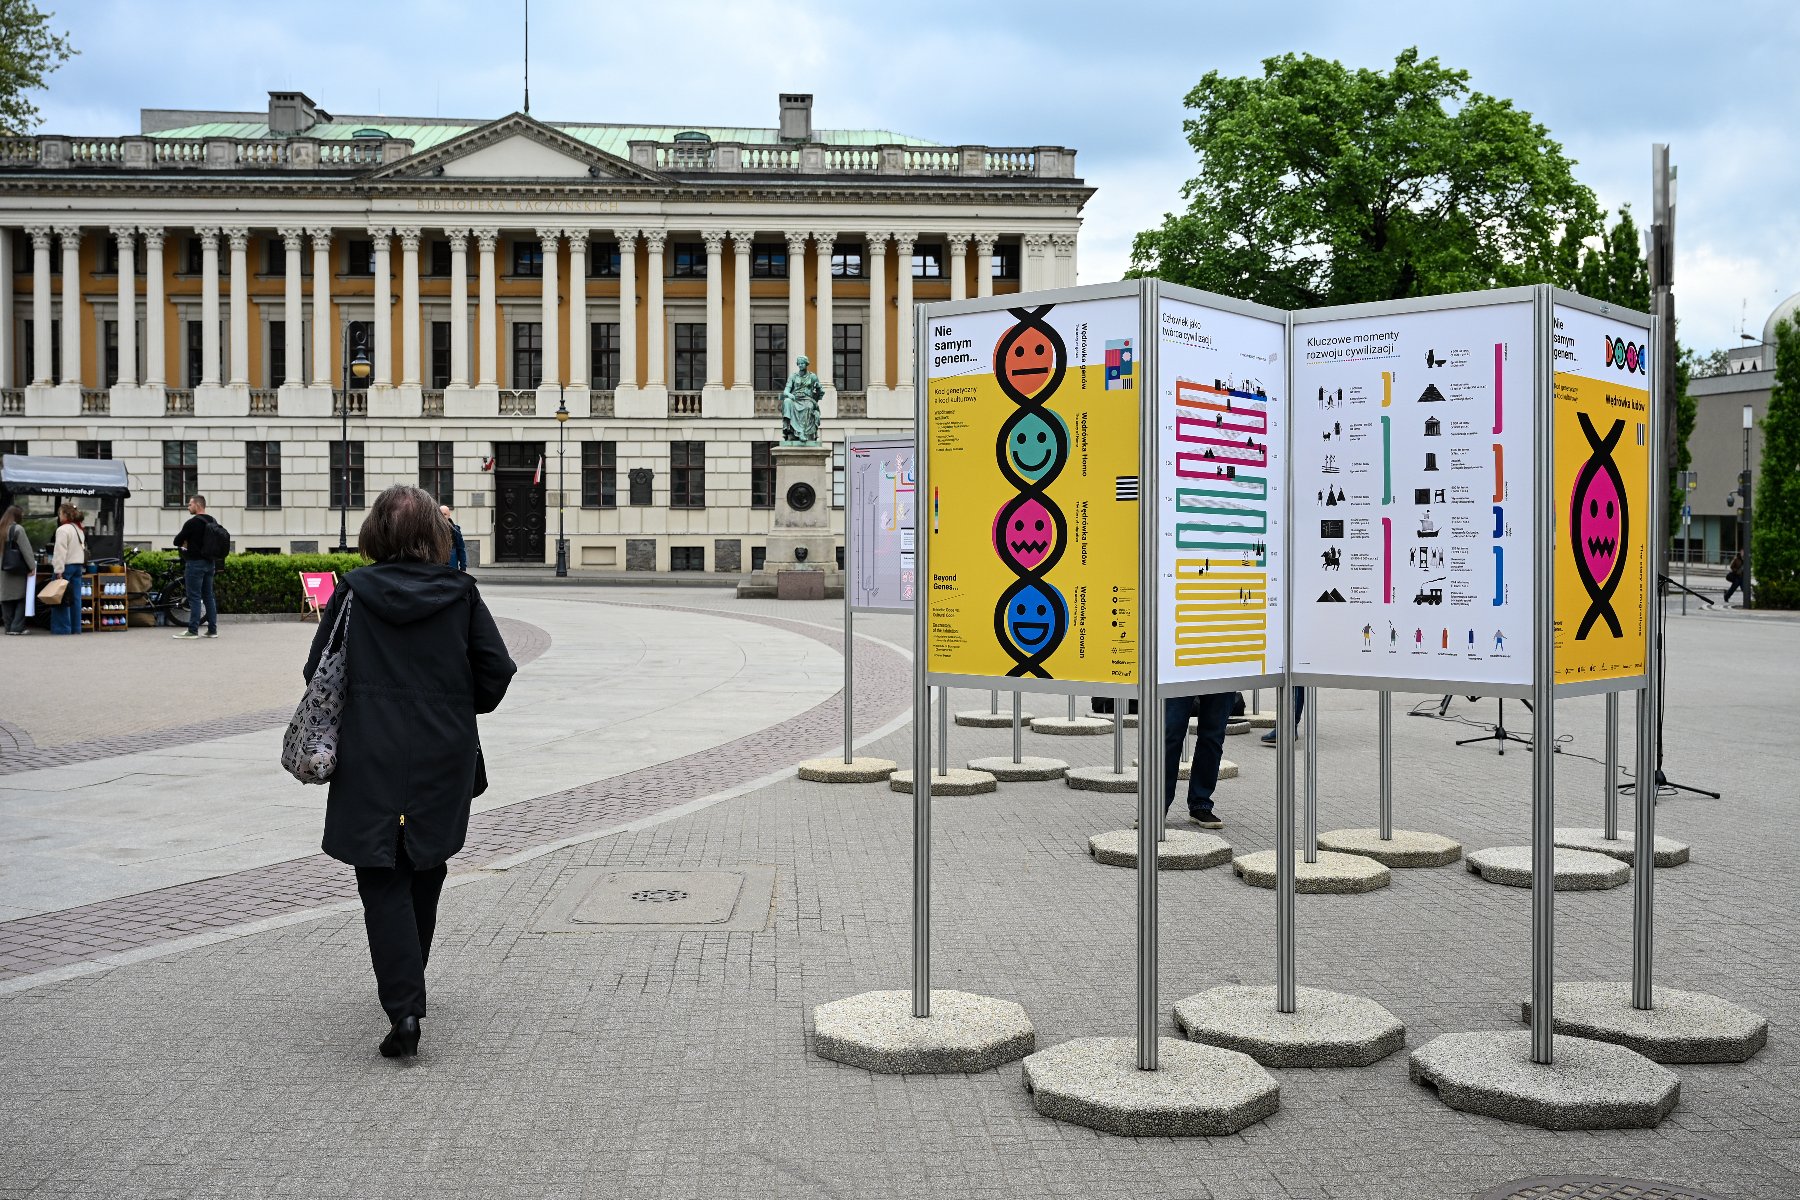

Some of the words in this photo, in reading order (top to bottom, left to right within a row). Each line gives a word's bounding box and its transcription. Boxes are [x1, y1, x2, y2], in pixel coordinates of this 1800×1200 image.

[935, 325, 952, 337] Nie
[1307, 336, 1352, 348] Kluczowe
[1353, 331, 1400, 343] momenty
[934, 339, 972, 352] samym
[1079, 322, 1088, 363] Wędrówka
[1306, 348, 1344, 360] rozwoju
[1345, 343, 1395, 358] cywilizacji
[934, 353, 978, 368] genem...
[1079, 365, 1088, 390] genów
[1080, 412, 1088, 452] Wędrówka
[41, 487, 96, 496] www.bikecafe.pl
[1080, 501, 1089, 541] Wędrówka
[933, 573, 957, 583] Beyond
[933, 582, 959, 591] Genes...
[1078, 585, 1087, 626] Wędrówka
[1079, 627, 1087, 659] Słowian
